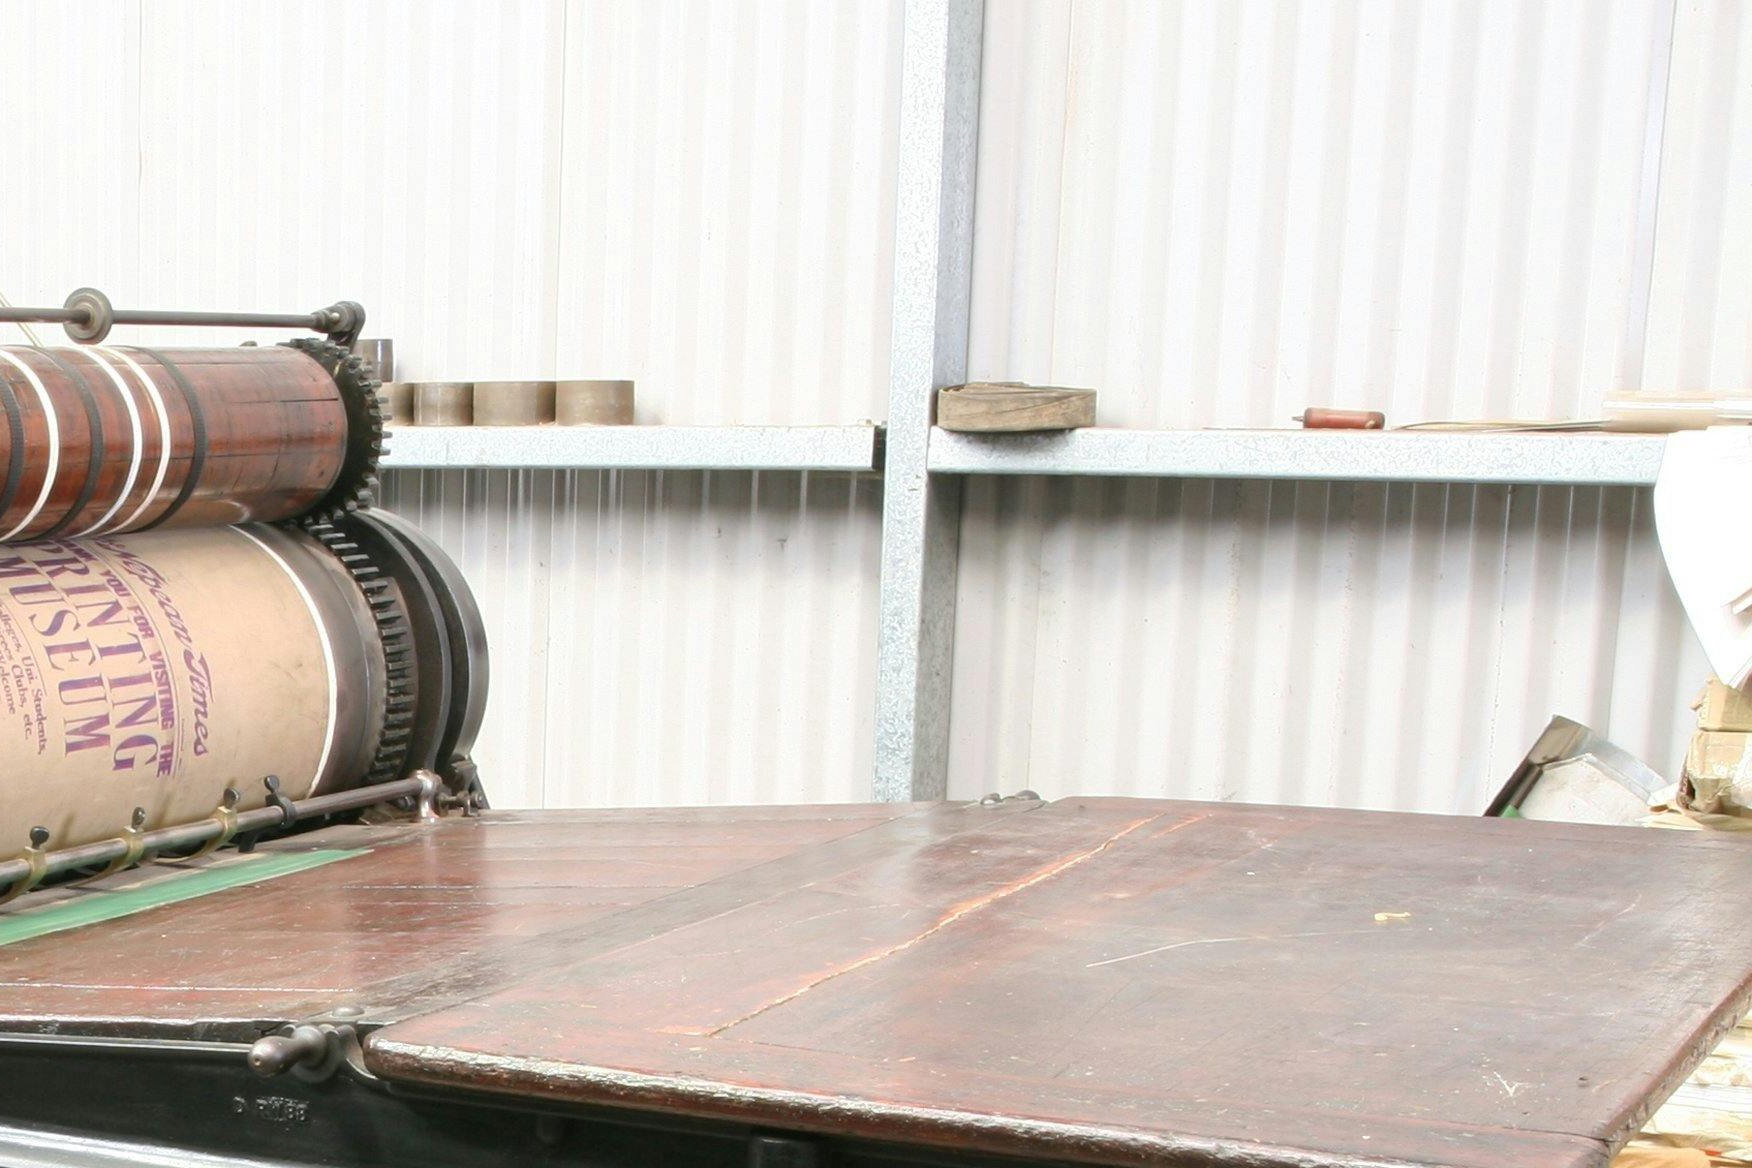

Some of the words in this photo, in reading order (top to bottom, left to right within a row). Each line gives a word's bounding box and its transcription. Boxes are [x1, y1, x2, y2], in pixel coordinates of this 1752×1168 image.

[98, 570, 131, 597] YOU
[127, 606, 154, 639] FOR
[4, 541, 159, 771] PRINTING
[149, 650, 175, 731] VISITING
[21, 656, 38, 684] Uni.
[31, 688, 49, 755] Students,
[183, 649, 214, 757] Times
[156, 740, 175, 778] THE
